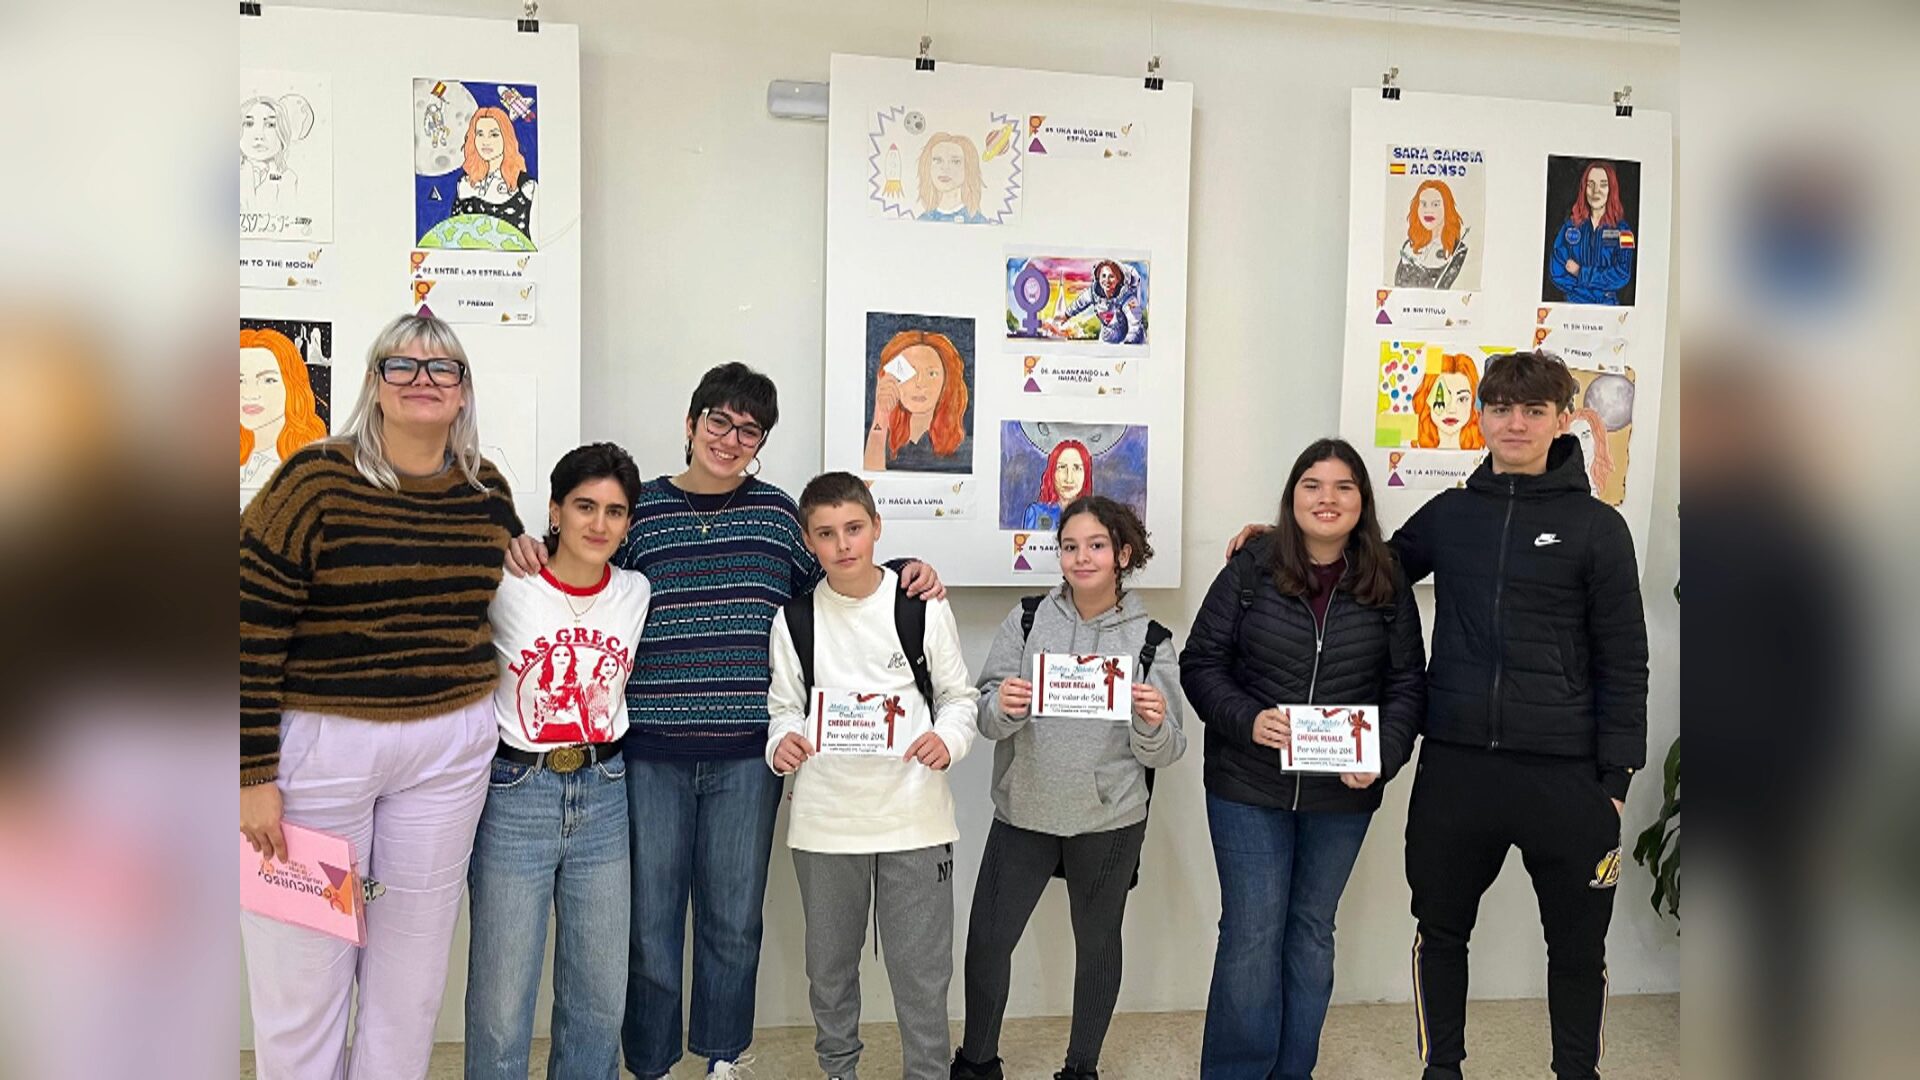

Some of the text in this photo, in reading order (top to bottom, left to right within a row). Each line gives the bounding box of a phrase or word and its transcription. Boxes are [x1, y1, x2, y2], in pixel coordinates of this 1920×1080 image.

[1393, 147, 1428, 160] SARA
[1410, 163, 1466, 177] ALONSO
[251, 259, 264, 267] TO
[266, 259, 282, 268] THE
[285, 261, 314, 269] MOON
[434, 267, 460, 275] ENTRE
[478, 269, 522, 278] ESTRELLAS
[508, 636, 551, 677] LAS
[1049, 681, 1096, 690] CHEQUE REGALO
[1048, 692, 1061, 701] Por
[1080, 693, 1089, 701] de
[828, 719, 876, 728] CHEQUE REGALO
[826, 731, 839, 739] Por
[841, 732, 859, 740] valor
[860, 732, 869, 740] de
[1297, 733, 1343, 743] CHEQUE REGALO
[1296, 745, 1309, 753] Por
[1311, 747, 1328, 755] valor
[1329, 746, 1338, 755] de
